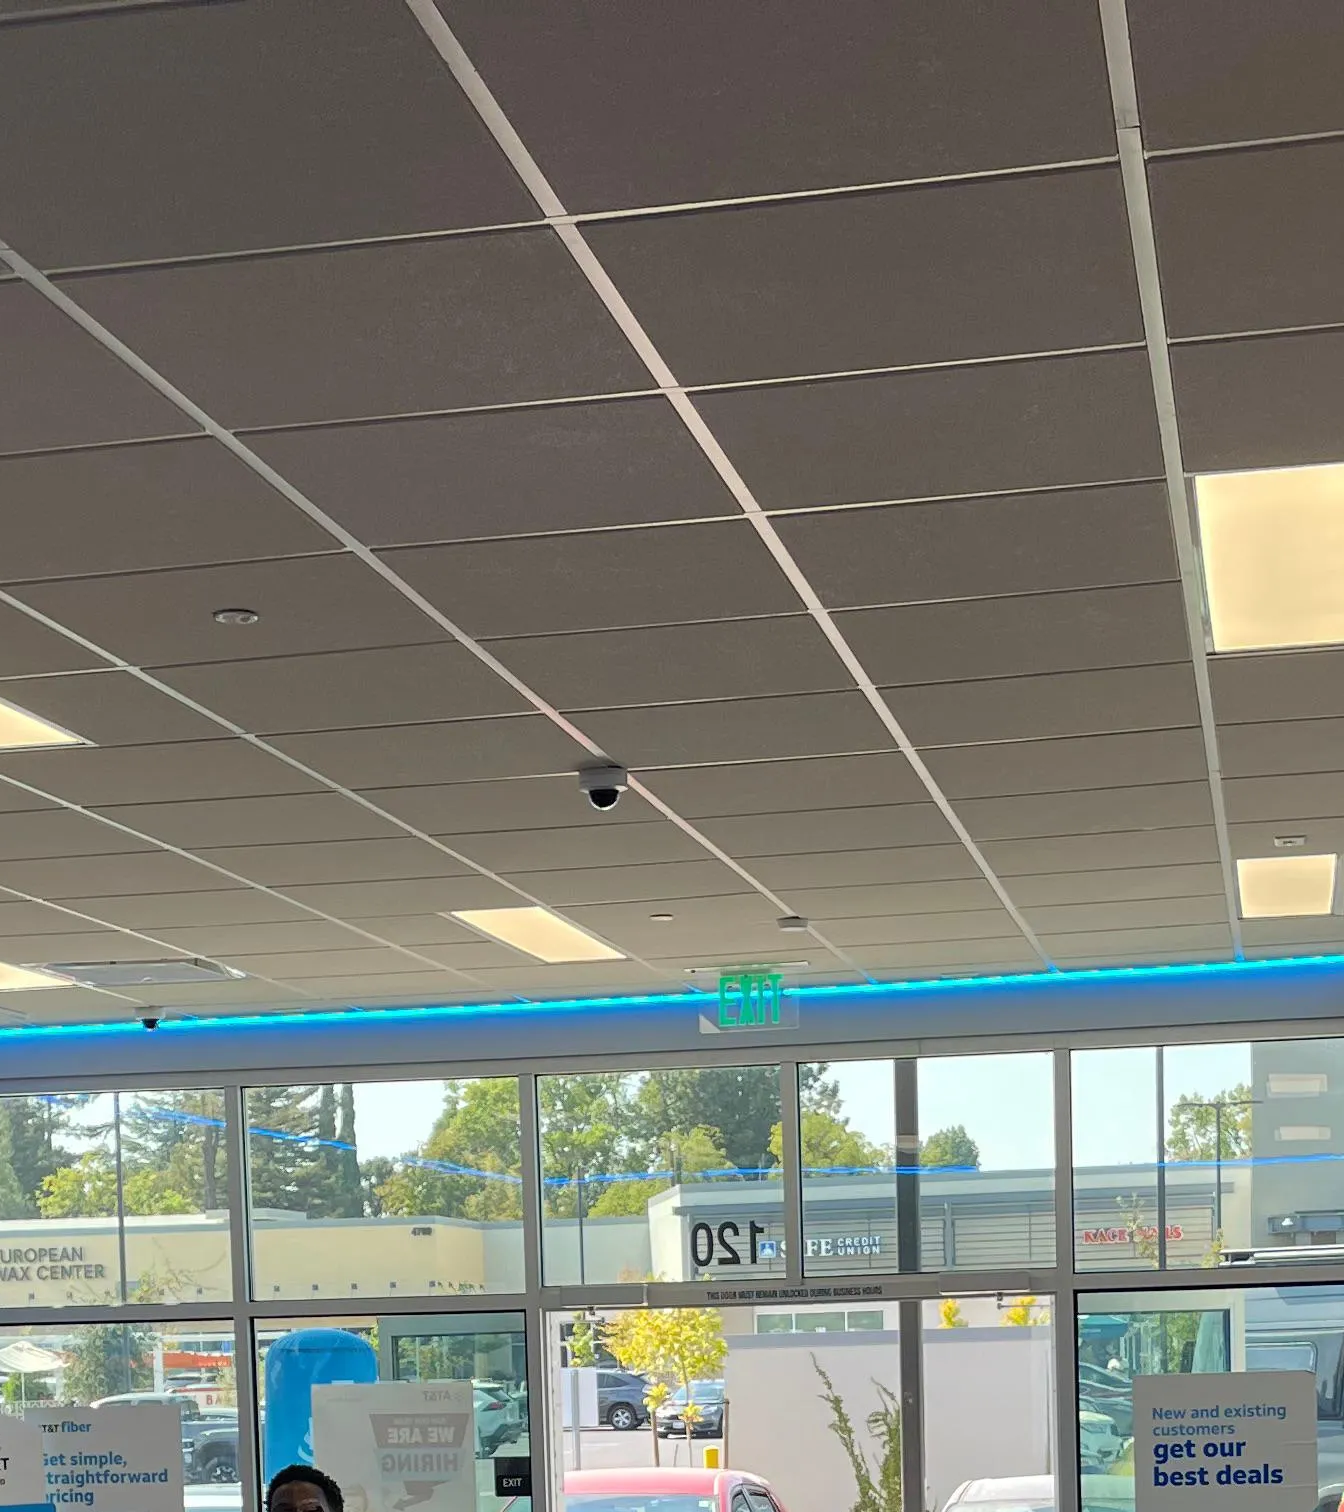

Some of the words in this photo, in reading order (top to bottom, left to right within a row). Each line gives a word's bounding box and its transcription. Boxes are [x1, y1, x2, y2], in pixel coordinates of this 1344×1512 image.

[719, 973, 784, 1027] EXIT
[780, 1238, 834, 1257] SFE
[837, 1236, 881, 1247] CREDIT
[837, 1245, 881, 1256] UNION
[36, 1264, 106, 1280] CENTER
[1152, 1407, 1186, 1420] New
[1191, 1405, 1219, 1419] and
[1224, 1404, 1286, 1420] existing
[41, 1424, 59, 1433] T&T
[61, 1421, 92, 1432] fiber
[1153, 1422, 1235, 1436] customers
[70, 1451, 127, 1469] simple,
[1153, 1441, 1196, 1464] get
[1203, 1440, 1246, 1458] our
[46, 1468, 168, 1488] traightforward
[502, 1477, 523, 1488] EXIT
[1154, 1466, 1209, 1486] best
[1216, 1463, 1284, 1485] deals
[45, 1488, 94, 1506] ricing
